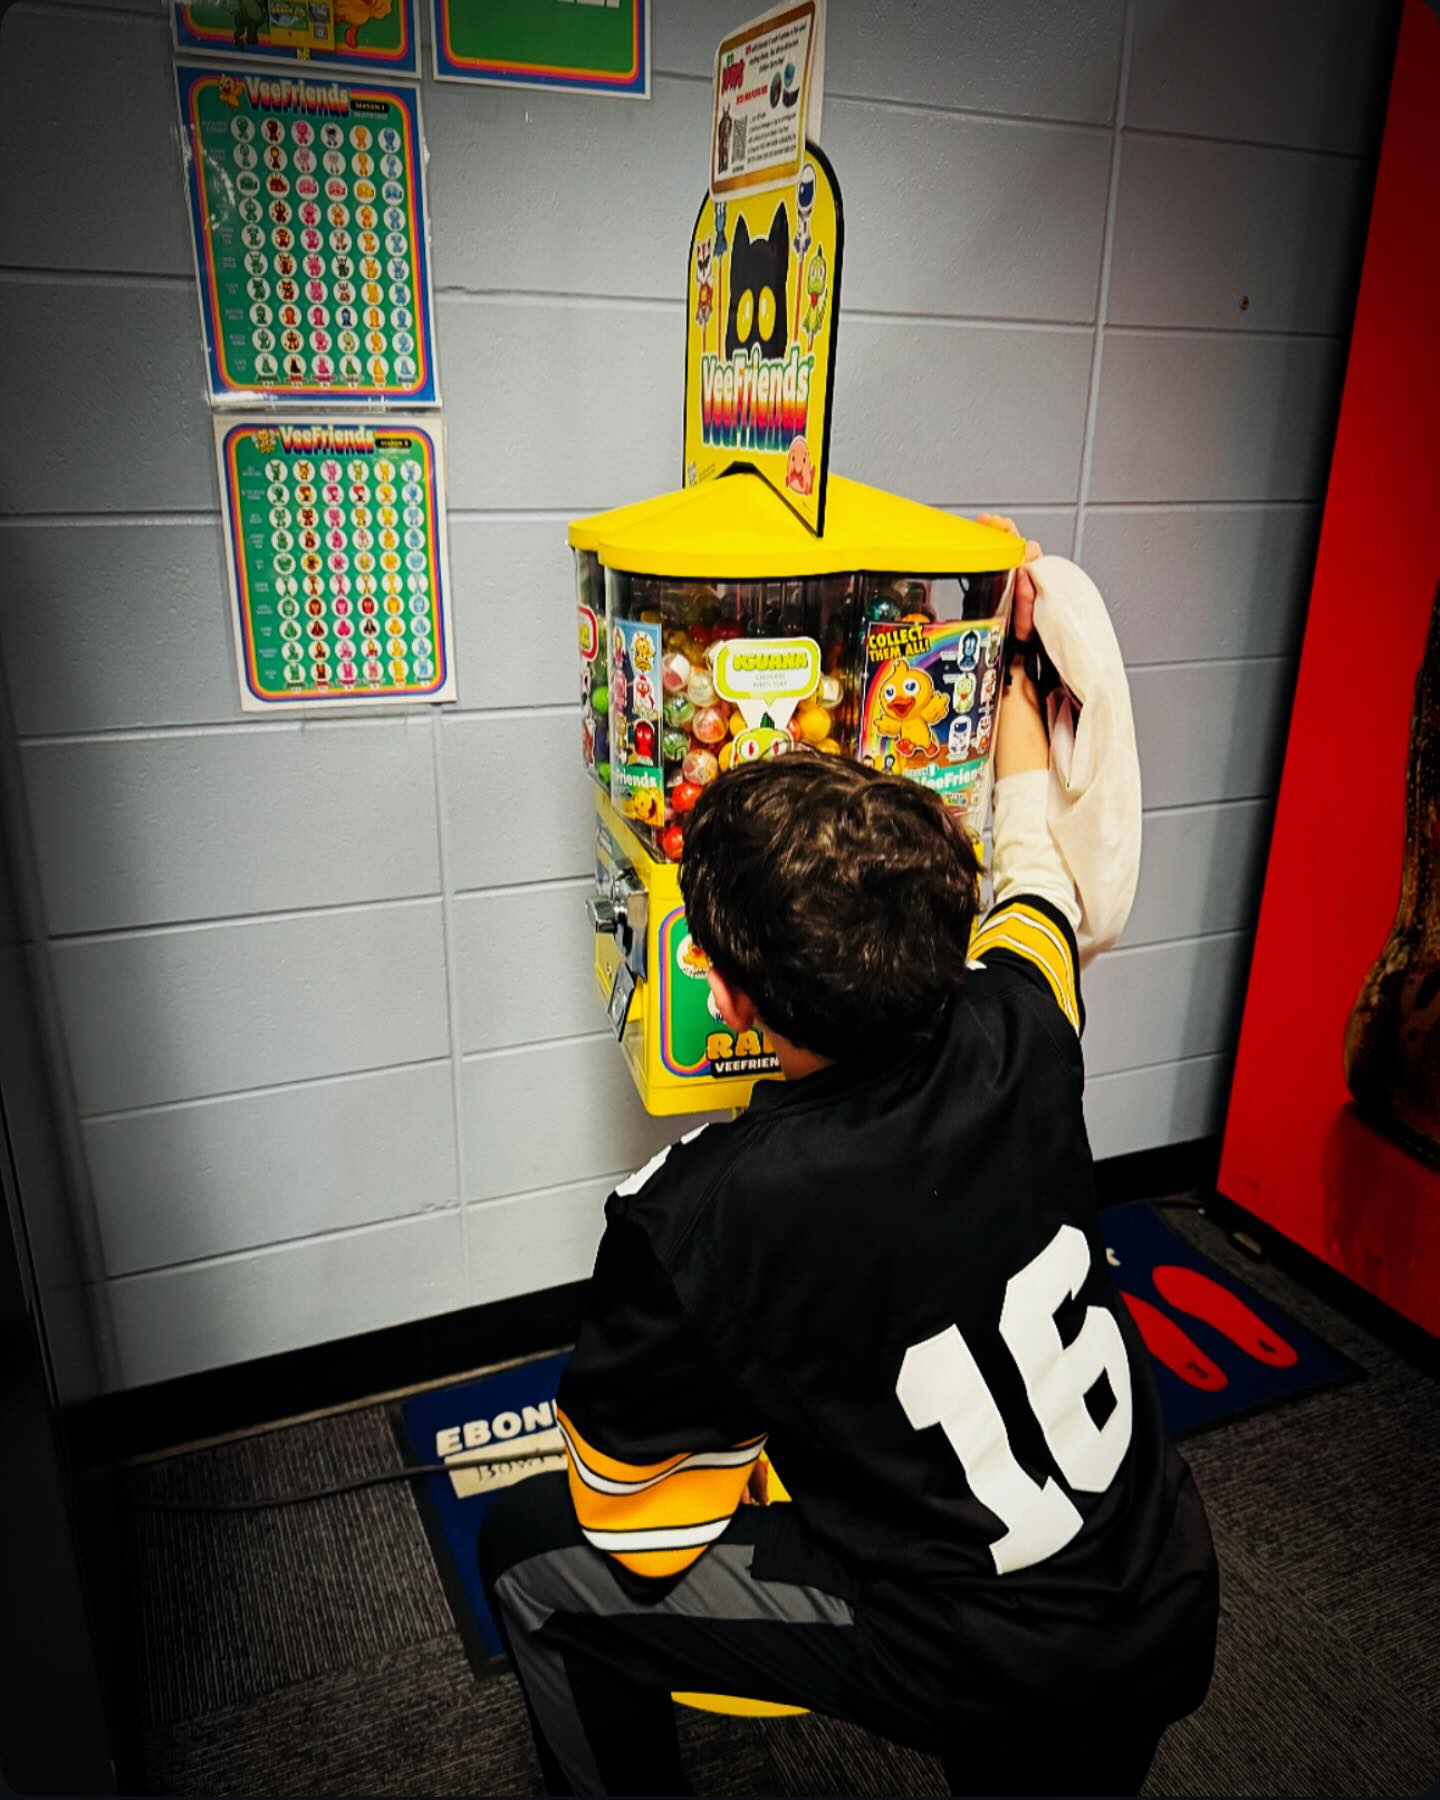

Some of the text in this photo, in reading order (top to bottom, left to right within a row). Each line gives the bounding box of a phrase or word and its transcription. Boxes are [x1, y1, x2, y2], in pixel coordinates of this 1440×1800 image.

[246, 76, 350, 118] VeeFriends
[701, 345, 814, 451] VeeFriends
[279, 425, 375, 454] VeeFriends
[868, 625, 923, 649] COLLECT
[869, 646, 902, 662] THEM
[905, 638, 930, 657] ALL!
[733, 652, 809, 672] IGUANA
[896, 1224, 1133, 1575] 16
